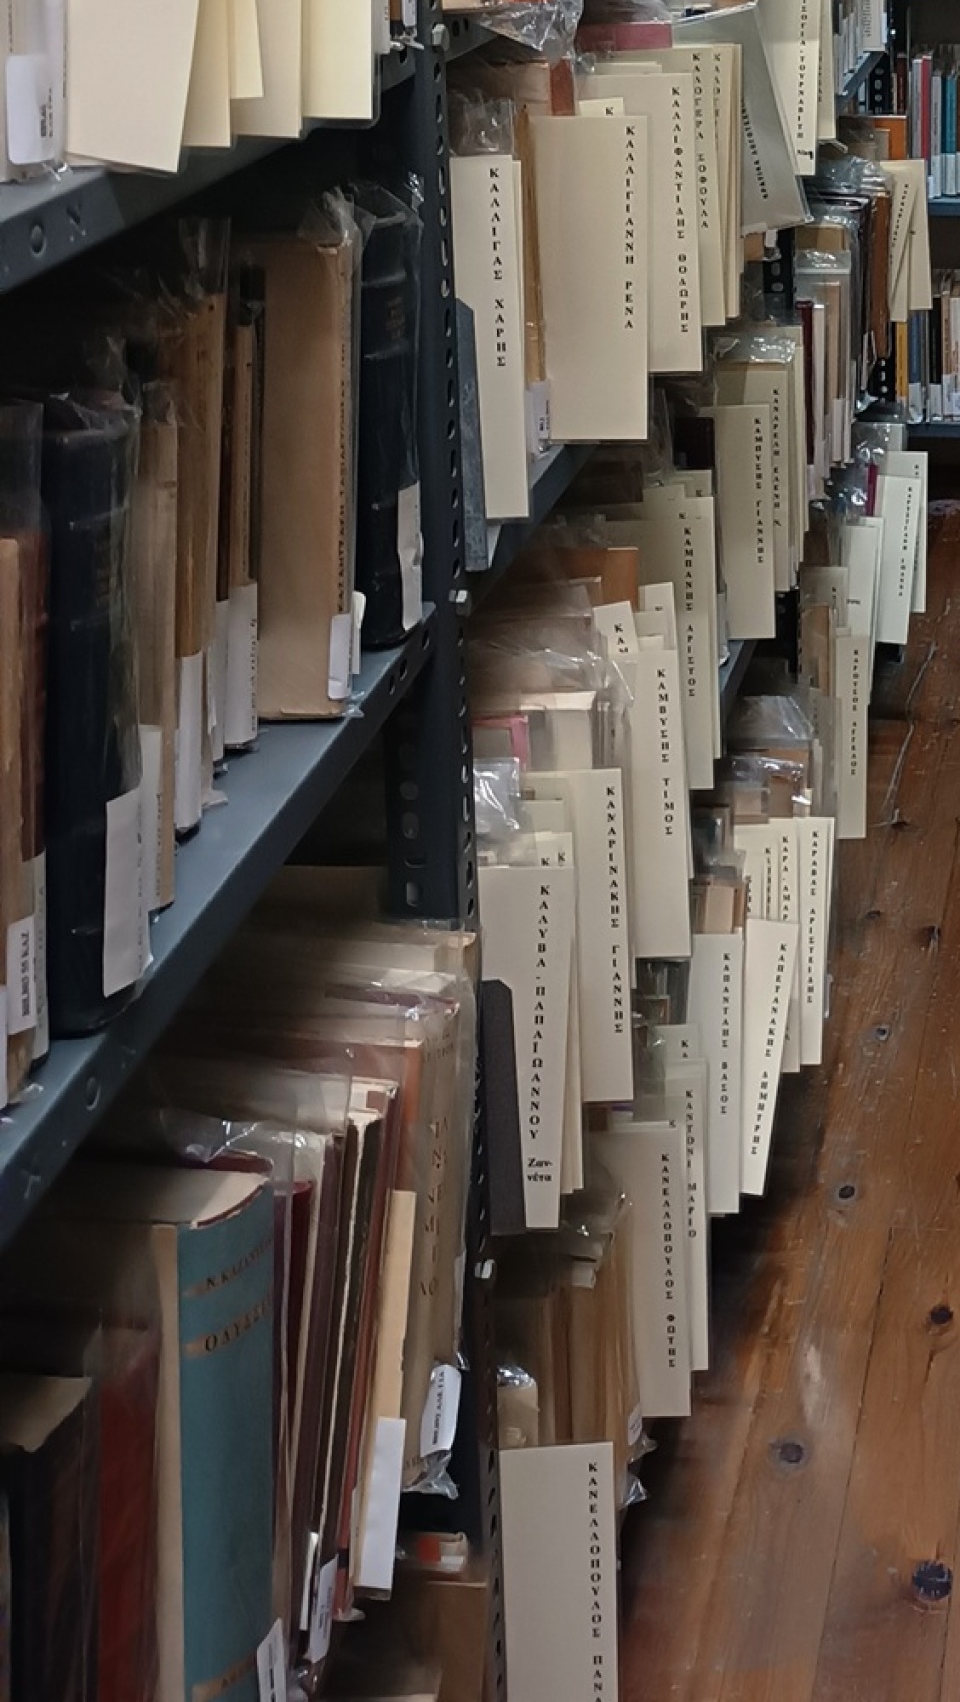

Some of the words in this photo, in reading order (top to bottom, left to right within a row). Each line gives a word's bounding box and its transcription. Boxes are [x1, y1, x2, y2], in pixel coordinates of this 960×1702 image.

[494, 298, 507, 367] ΧΑΡΗΣ
[624, 280, 634, 330] ΡΕΝΑ
[662, 777, 675, 836] ΤΙΜΟΣ
[612, 945, 624, 1034] ΓΙΑΝΝΗΣ
[588, 1462, 602, 1638] ΚΑΝΕΛΛΟΠΟΥΛΟΣ
